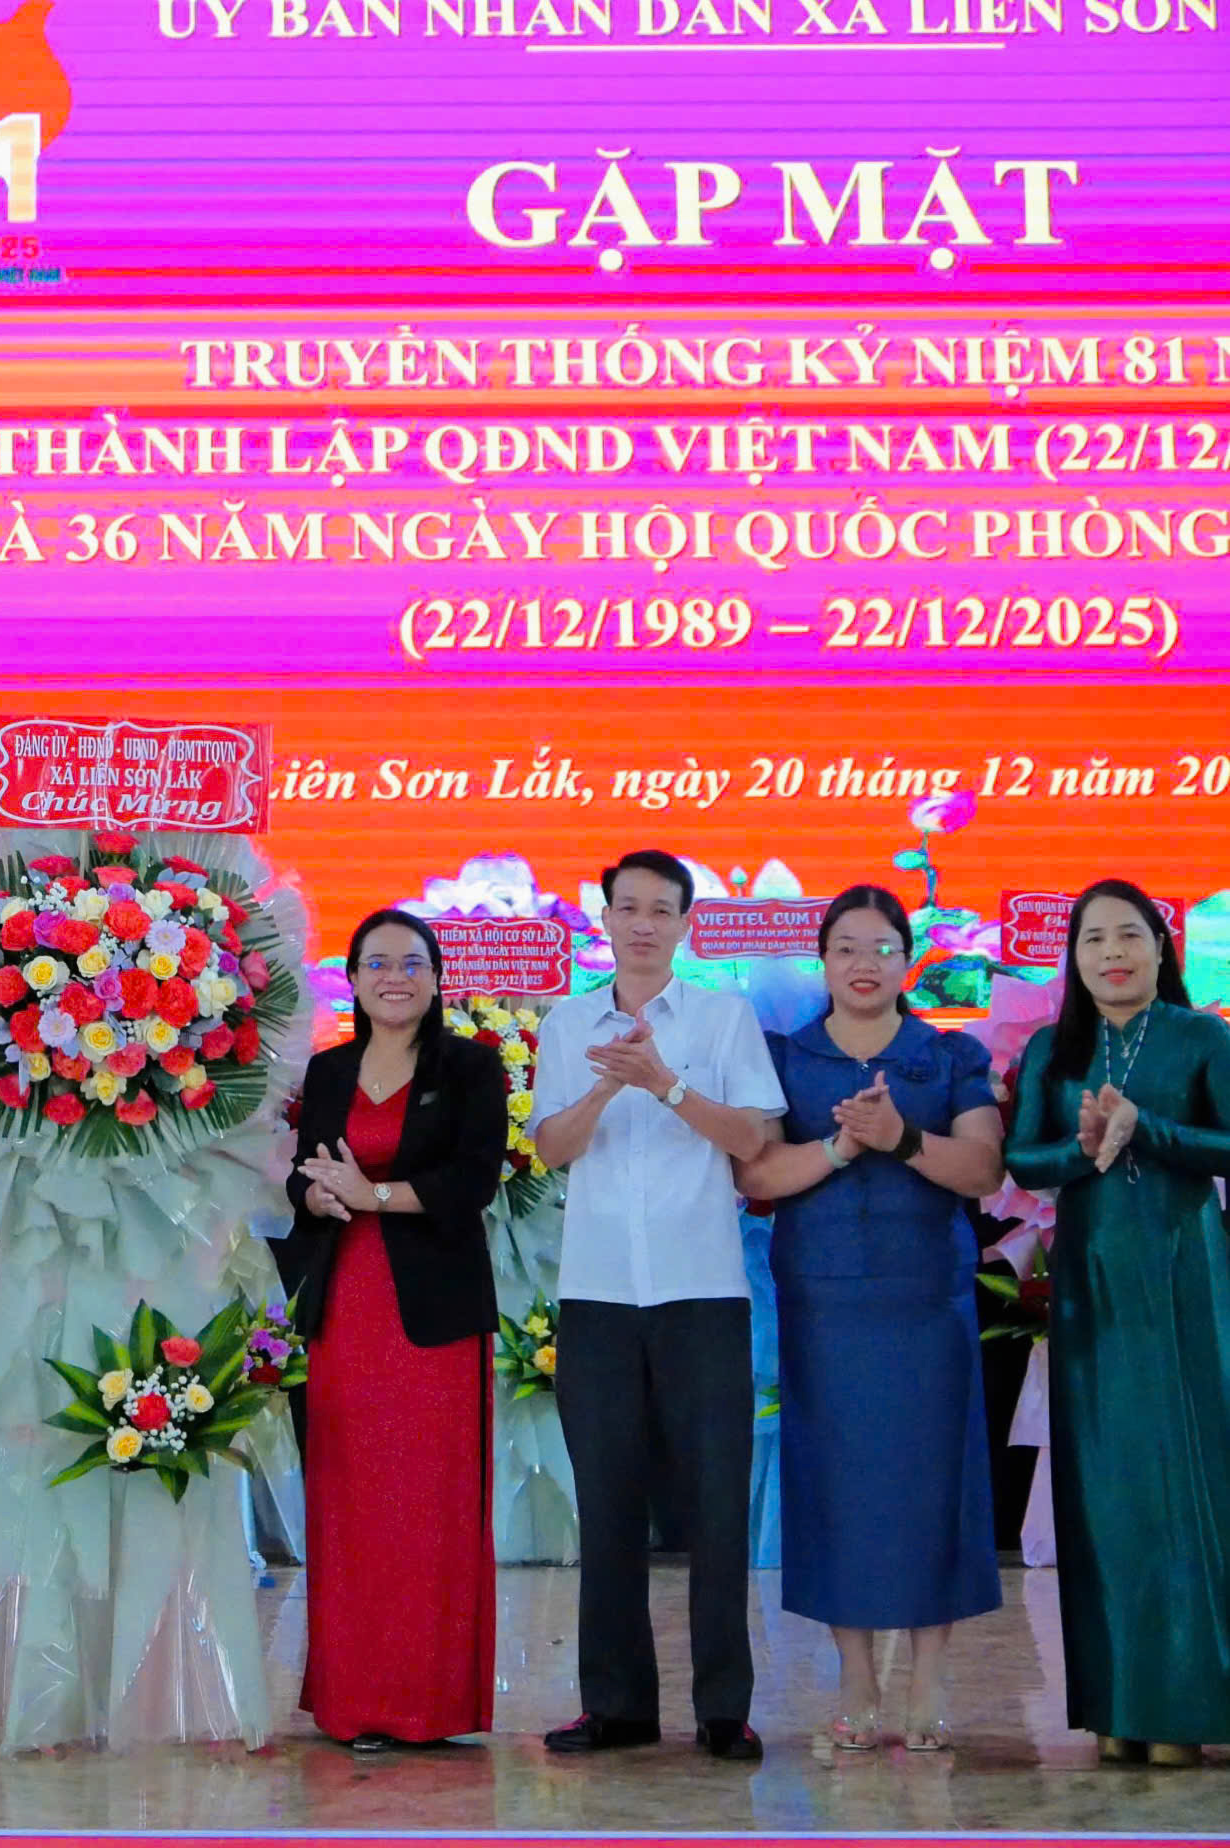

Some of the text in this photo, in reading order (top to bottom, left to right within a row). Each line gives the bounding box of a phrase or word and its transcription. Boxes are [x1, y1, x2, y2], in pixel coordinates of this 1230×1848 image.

[270, 0, 399, 37] BAN
[467, 147, 1077, 270] GẶP MẶT
[181, 325, 480, 387] TRUYỀN
[501, 324, 764, 385] THỐNG
[788, 323, 889, 384] KỶ
[912, 329, 1102, 397] NIỆM
[1124, 336, 1186, 384] 81
[269, 418, 408, 486] LẬP
[424, 424, 632, 484] QĐND
[654, 417, 826, 485] VIỆT
[847, 424, 1010, 471] NAM
[66, 514, 138, 562] 36
[159, 500, 325, 560] NĂM
[350, 498, 558, 560] NGÀY
[578, 504, 712, 572] HỘI
[735, 497, 946, 569] QUỐC
[971, 496, 1230, 558] PHÒNG
[400, 598, 751, 659] (22/12/1989
[826, 597, 1178, 656] 22/12/2025)
[15, 729, 49, 758] ĐẢNG
[78, 736, 114, 760] HĐND
[124, 738, 158, 760] UBND
[50, 762, 74, 785] XÃ
[80, 762, 119, 787] LIÊN
[167, 763, 202, 789] LẮK
[21, 790, 222, 821] Chúc Mừng
[372, 760, 468, 799] Sơn
[487, 746, 593, 805] Lắk,
[612, 757, 730, 808] ngày
[746, 757, 804, 796] 20
[818, 757, 960, 799] tháng
[979, 757, 1034, 795] 12
[1050, 757, 1154, 795] năm
[1172, 756, 1230, 795] 20
[697, 911, 768, 926] VIETTEL
